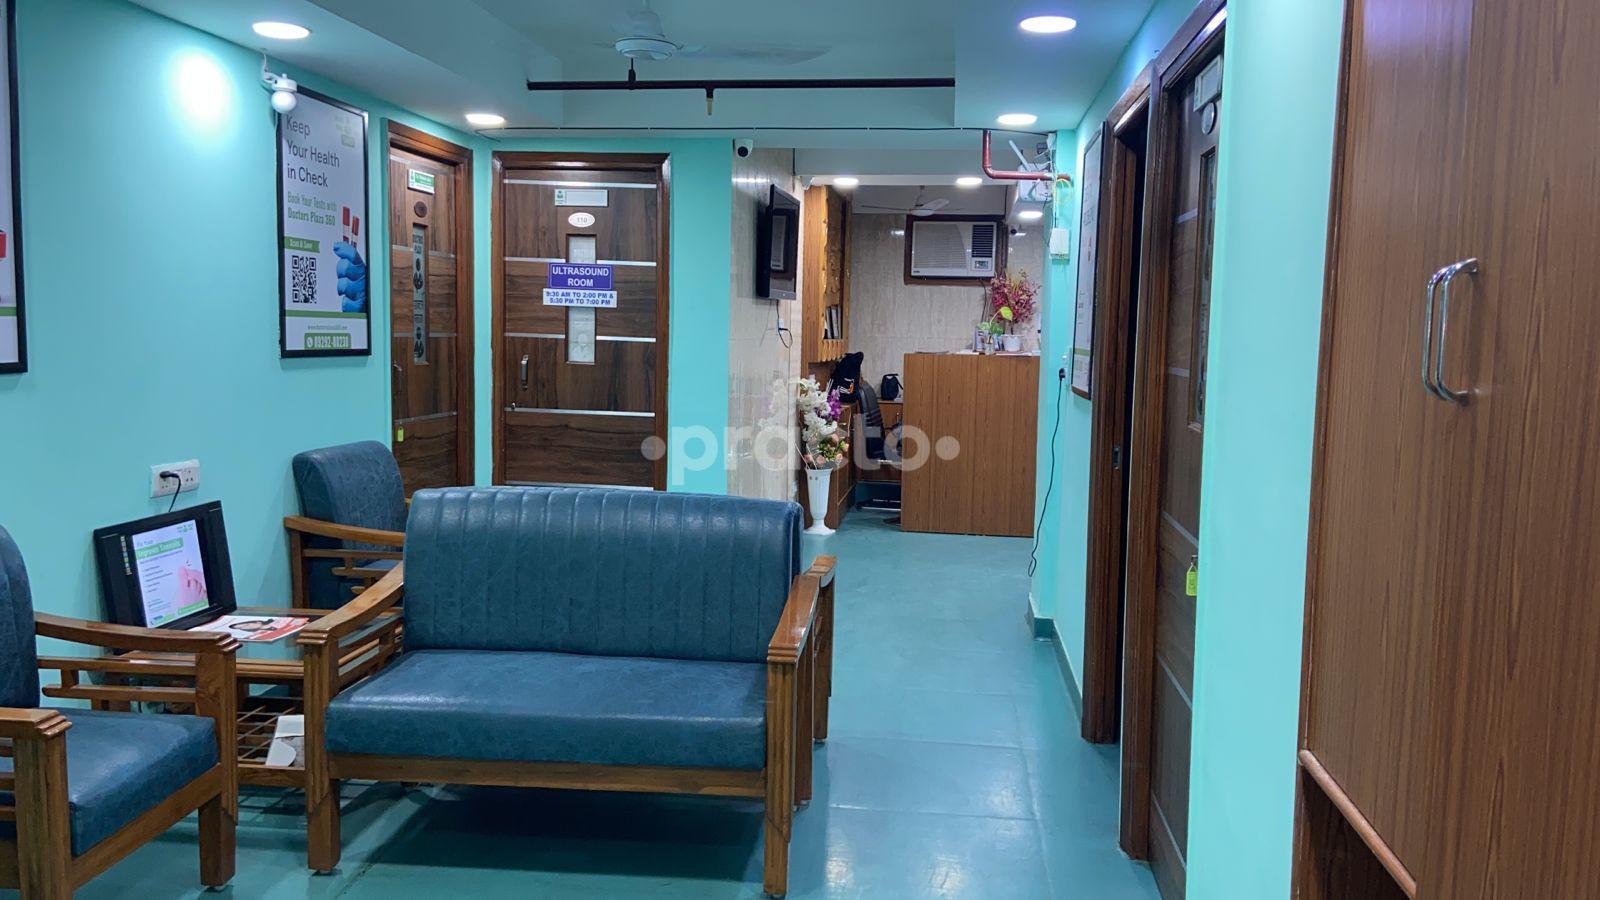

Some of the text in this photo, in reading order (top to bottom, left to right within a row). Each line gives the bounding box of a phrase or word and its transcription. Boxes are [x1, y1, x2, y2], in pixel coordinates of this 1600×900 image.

[286, 114, 311, 139] Keep
[287, 140, 340, 168] Your Health
[287, 163, 328, 187] in Check
[288, 191, 300, 204] Book
[288, 206, 309, 221] Doctors
[552, 266, 609, 276] ULTRASOUND
[567, 278, 594, 287] ROOM
